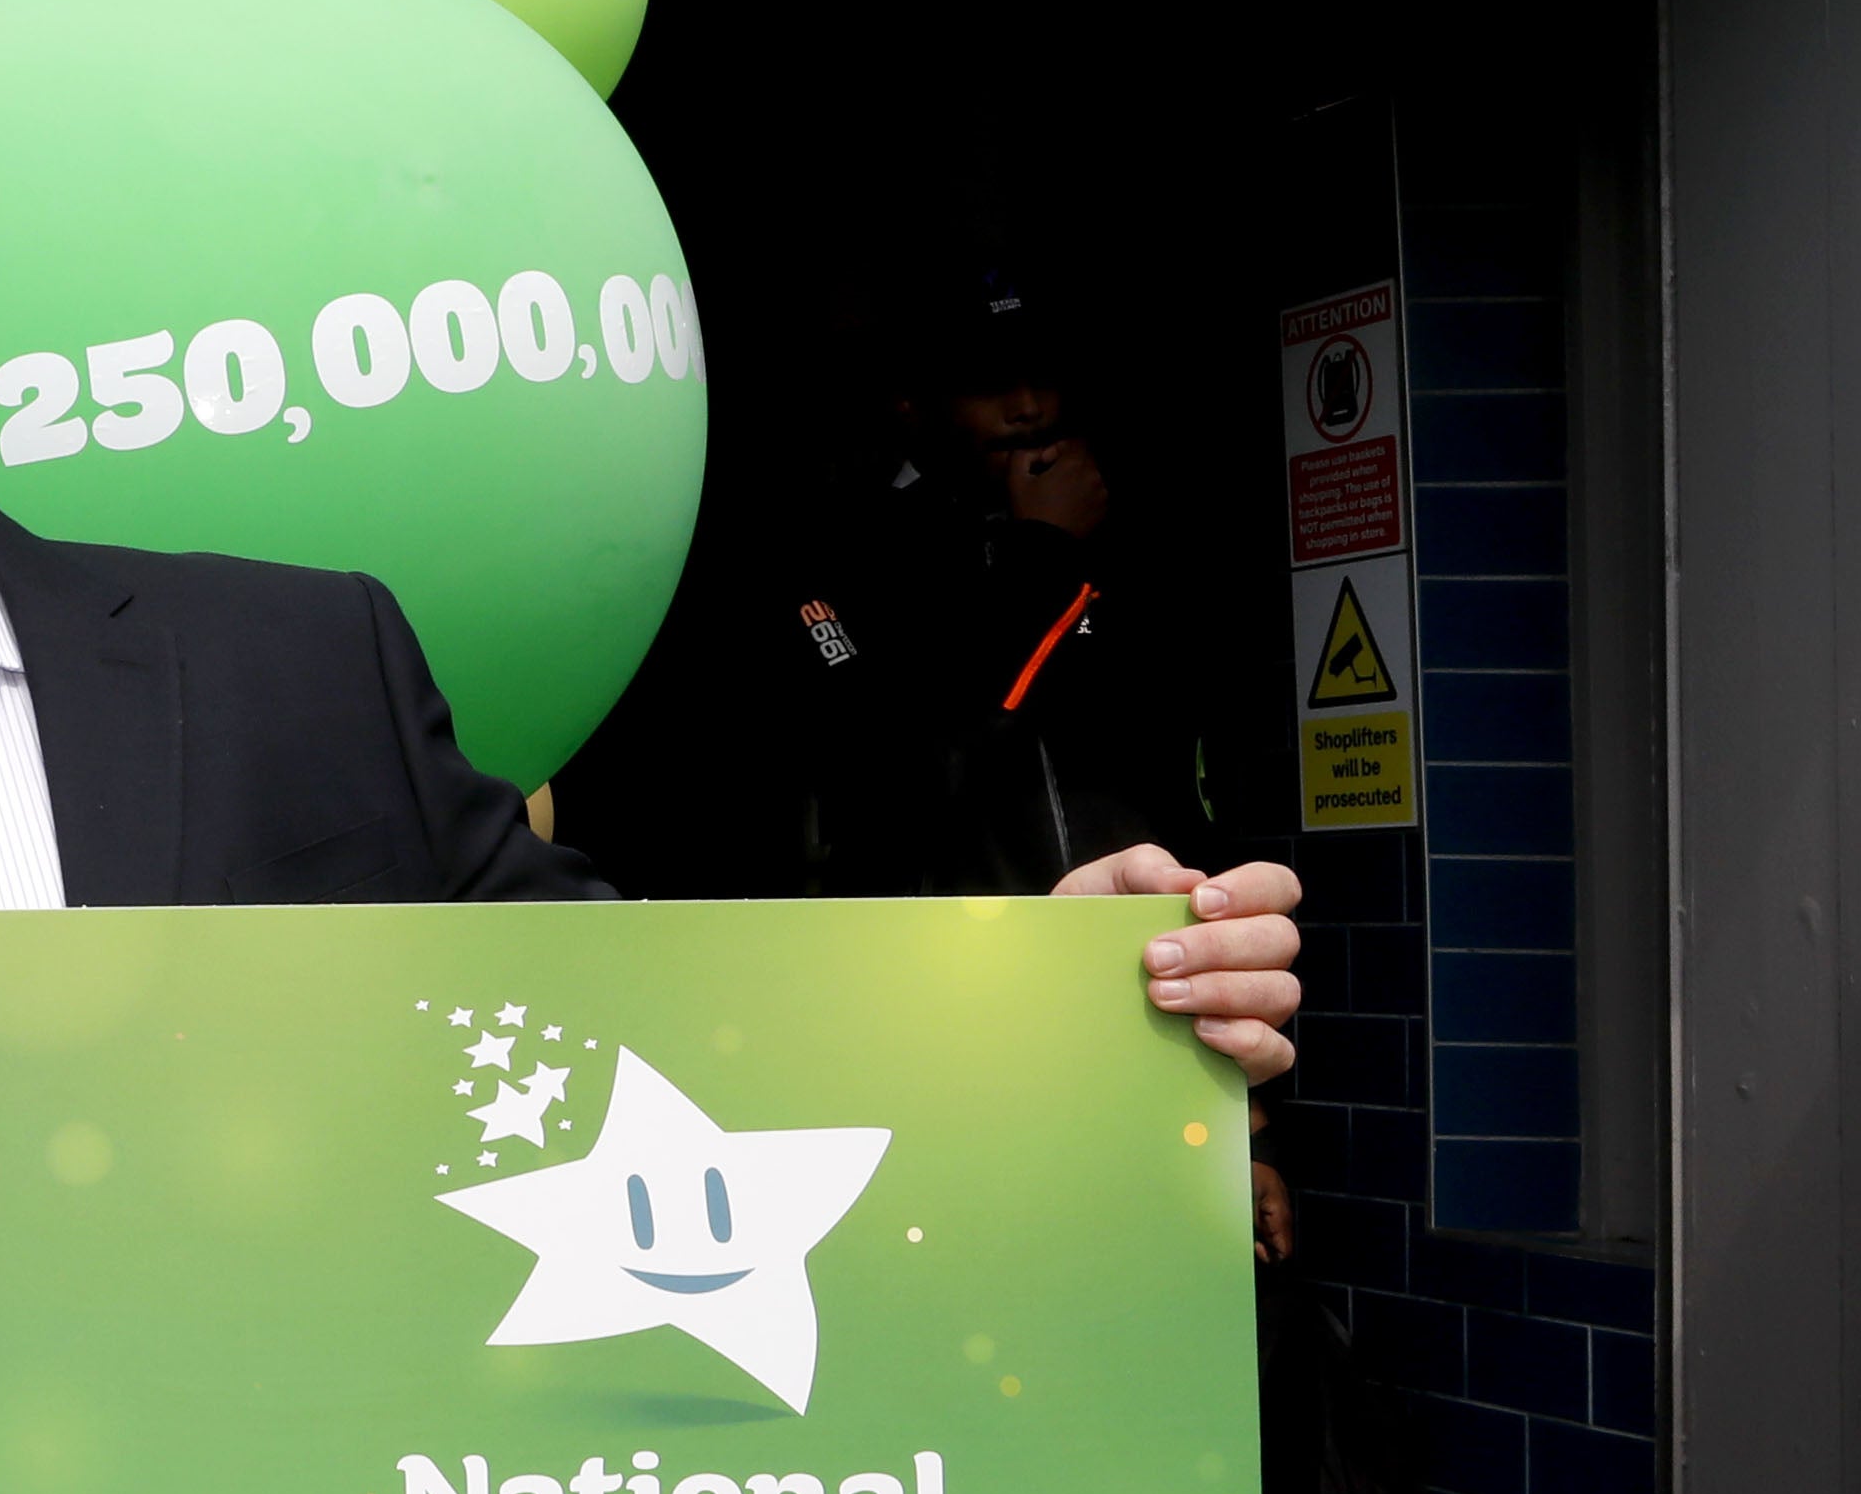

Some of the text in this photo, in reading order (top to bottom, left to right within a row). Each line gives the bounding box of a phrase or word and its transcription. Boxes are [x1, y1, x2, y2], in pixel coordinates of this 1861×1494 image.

[1287, 292, 1386, 340] ATTENTION
[1301, 446, 1386, 472] Please use baskets
[1309, 464, 1378, 488] provided when
[1345, 483, 1362, 495] The
[1363, 479, 1380, 492] use
[1381, 475, 1391, 488] of
[1299, 493, 1393, 520] backpacks or bags is
[1300, 509, 1394, 535] NOT permitted when
[1306, 533, 1349, 550] shopping
[1349, 531, 1359, 542] in
[1314, 727, 1397, 753] Shoplifters
[1332, 756, 1381, 779] will be
[1315, 785, 1402, 813] prosecuted
